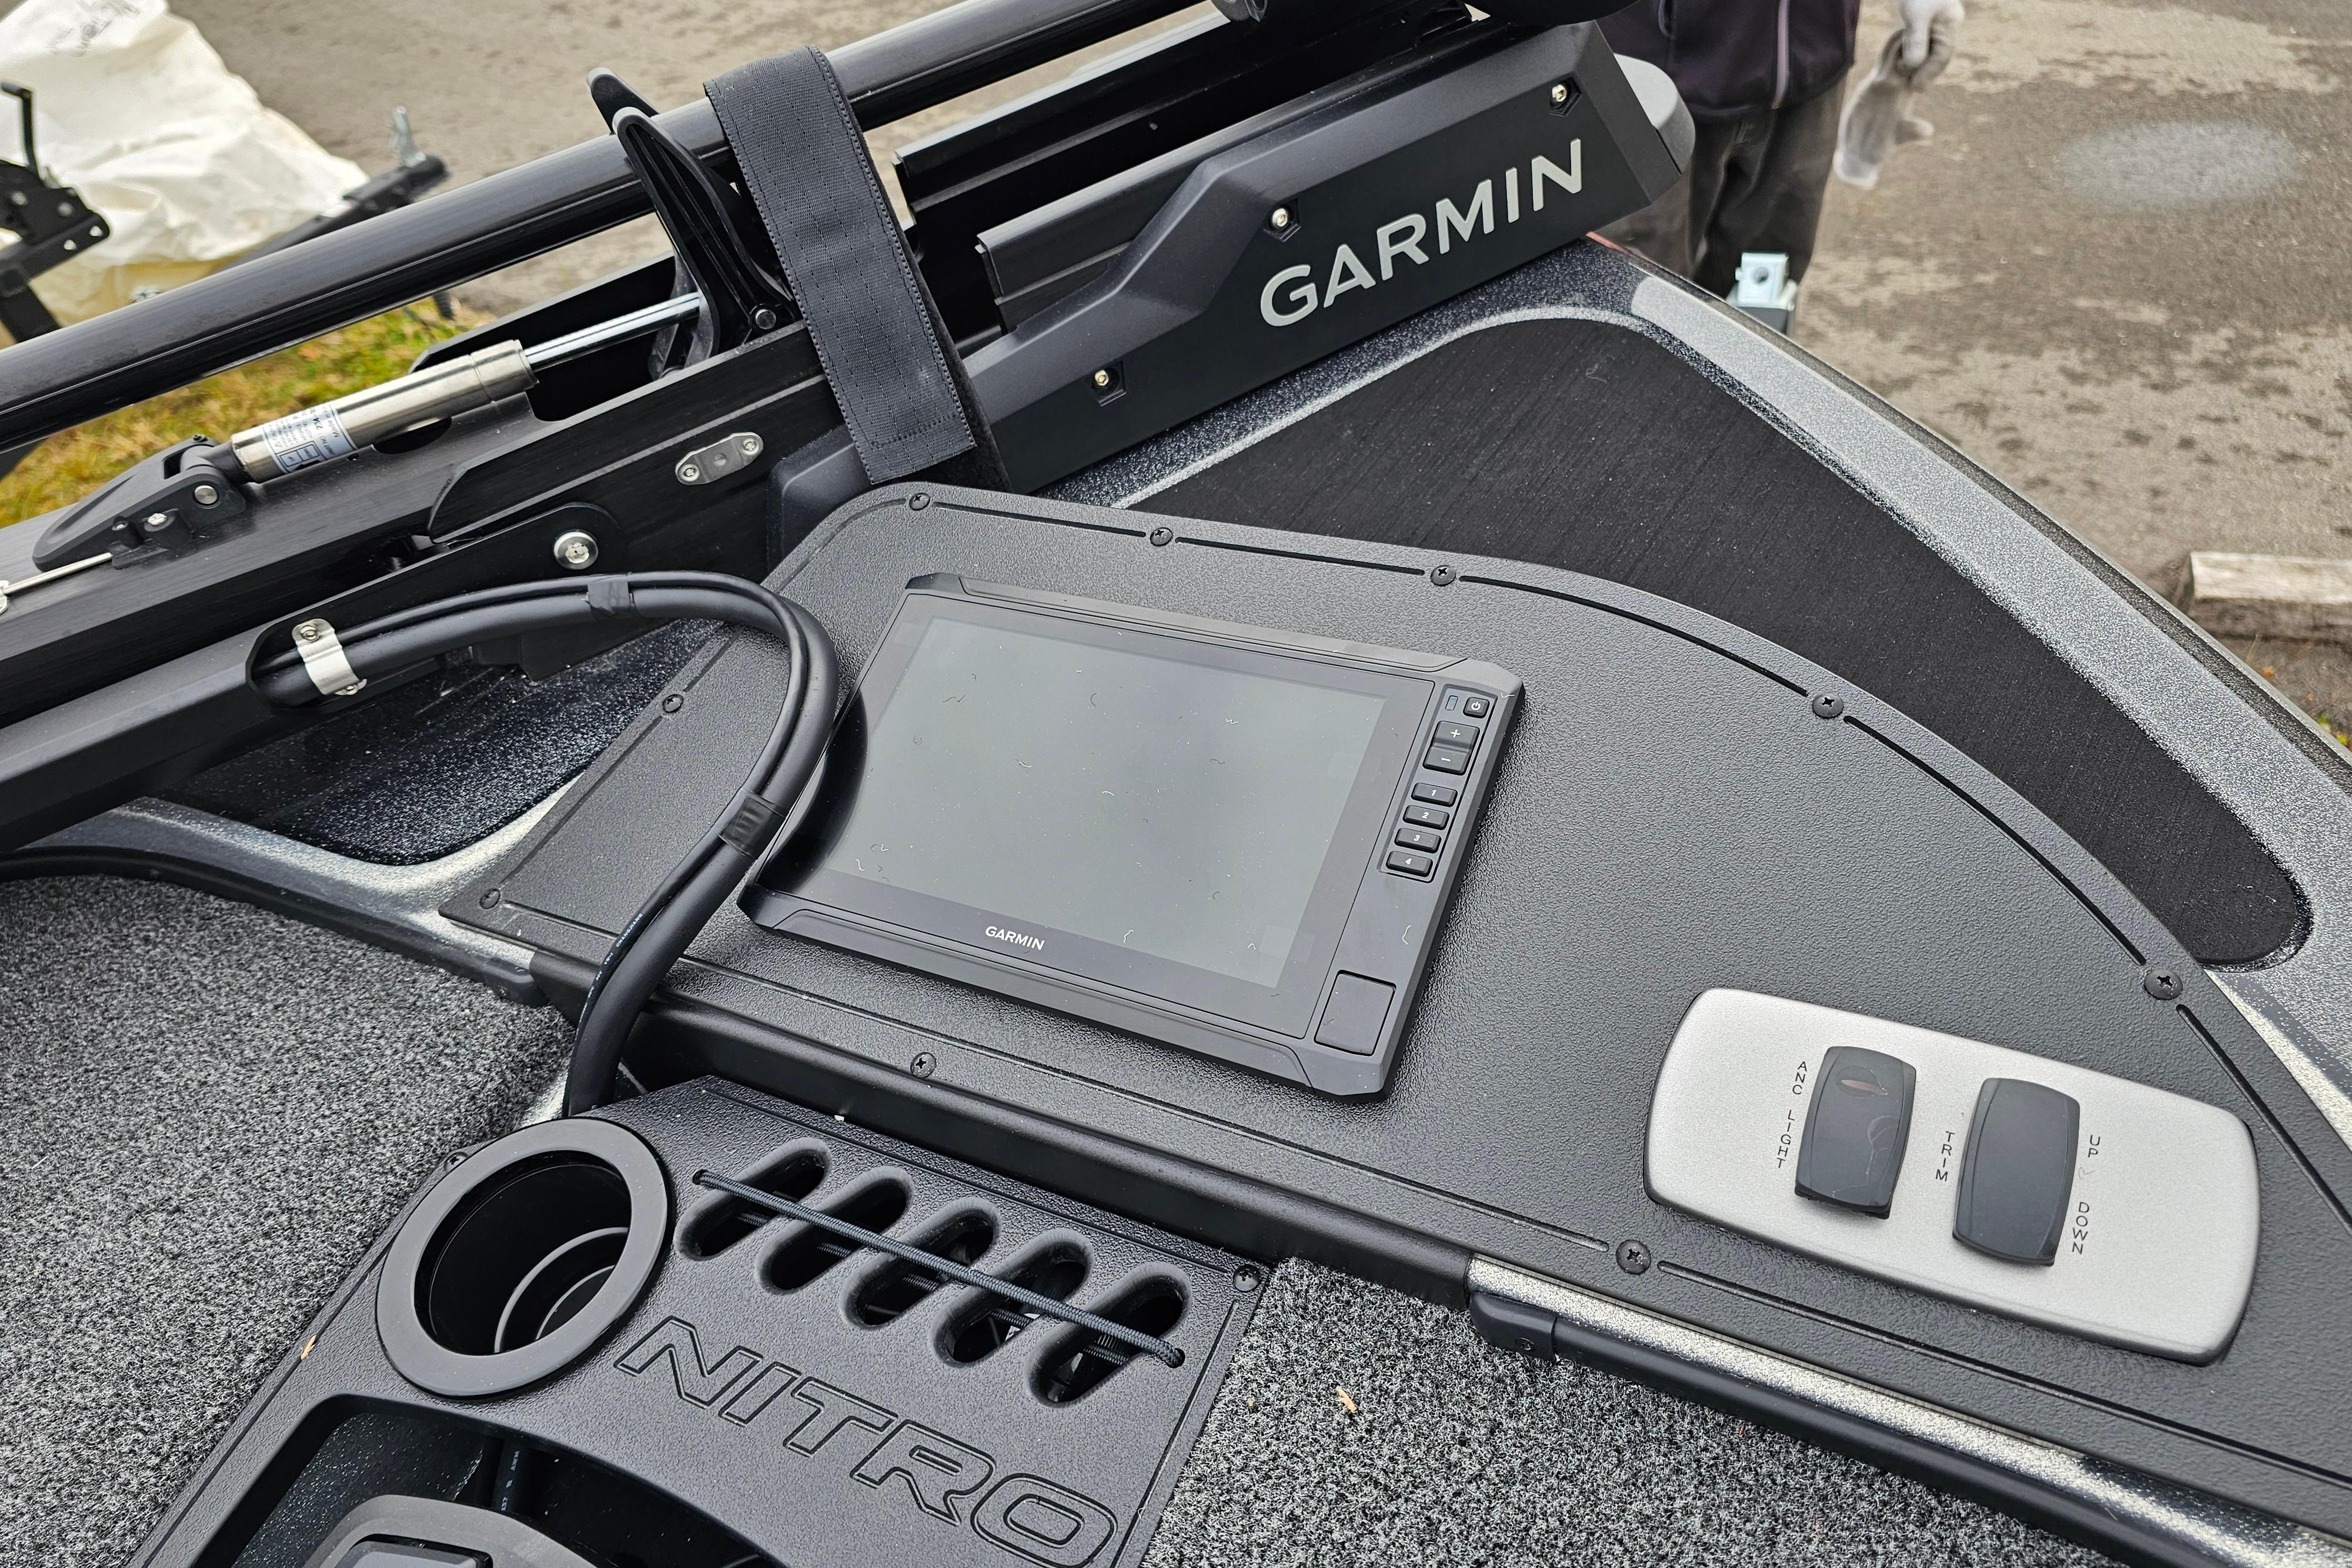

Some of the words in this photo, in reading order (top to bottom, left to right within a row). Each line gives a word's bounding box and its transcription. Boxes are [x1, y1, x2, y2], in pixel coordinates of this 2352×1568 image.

[1260, 138, 1581, 326] GARMIN
[616, 913, 643, 947] CHANGJIANG
[985, 925, 1045, 951] GARMIN
[1792, 1061, 1807, 1095] ANC
[1776, 1109, 1795, 1169] LIGHT
[1935, 1131, 1954, 1182] TRIM
[2087, 1135, 2100, 1158] UP
[2072, 1202, 2090, 1255] DOWN
[613, 1315, 1118, 1568] NITRO
